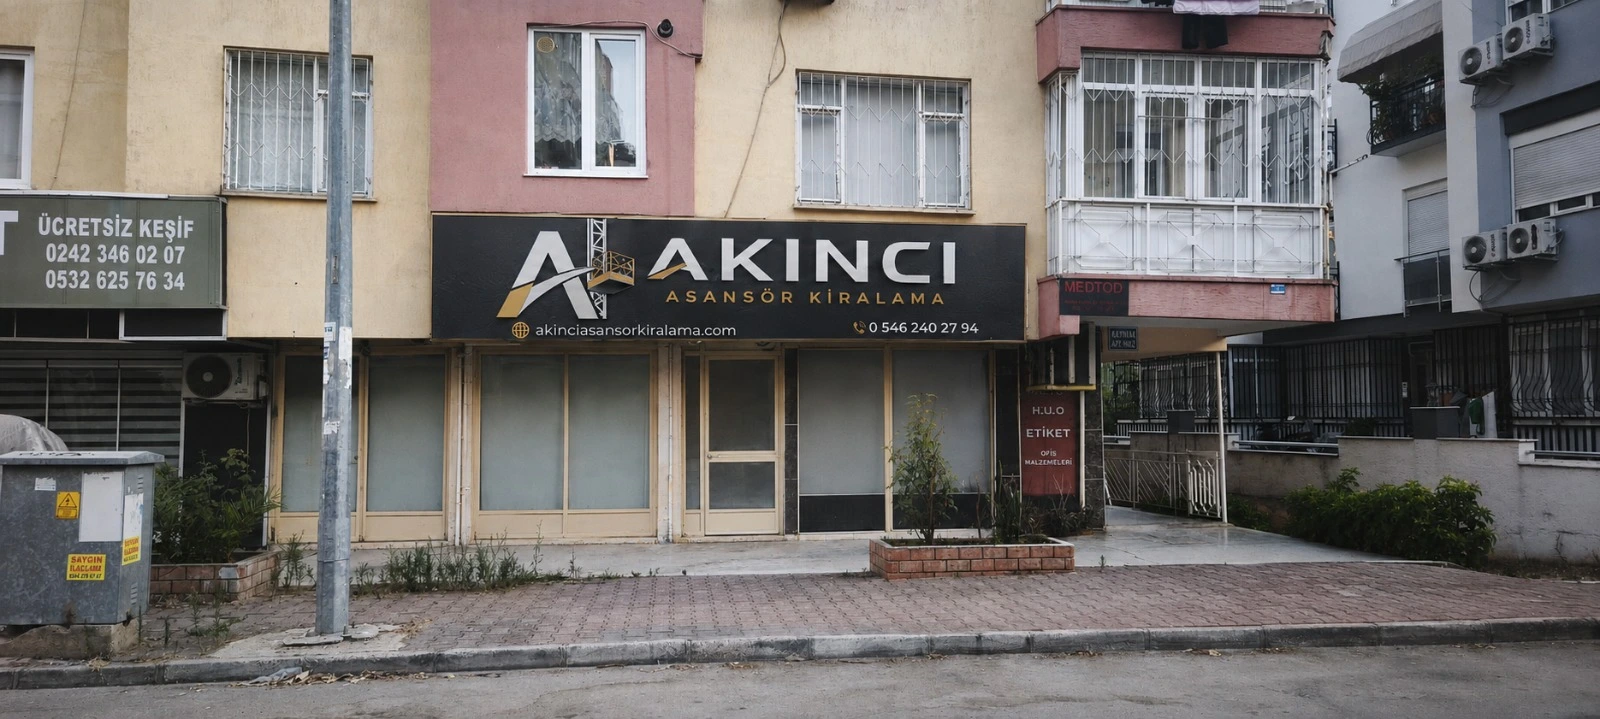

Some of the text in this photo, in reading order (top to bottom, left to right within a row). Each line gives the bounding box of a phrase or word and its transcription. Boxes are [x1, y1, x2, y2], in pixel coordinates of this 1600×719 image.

[38, 213, 194, 243] ÜCRETSİZ KEŞİF
[46, 243, 186, 264] 0242 346 02 07
[647, 238, 956, 284] AKINCI
[45, 269, 185, 291] 0532 625 76 34
[1064, 281, 1124, 294] MEDTOD
[666, 288, 945, 306] ASANSÖR KİRALAMA
[536, 323, 737, 338] akinciasansorkiralama.com
[868, 322, 980, 334] 0 546 240 27 94
[1026, 426, 1071, 438] ETİKET
